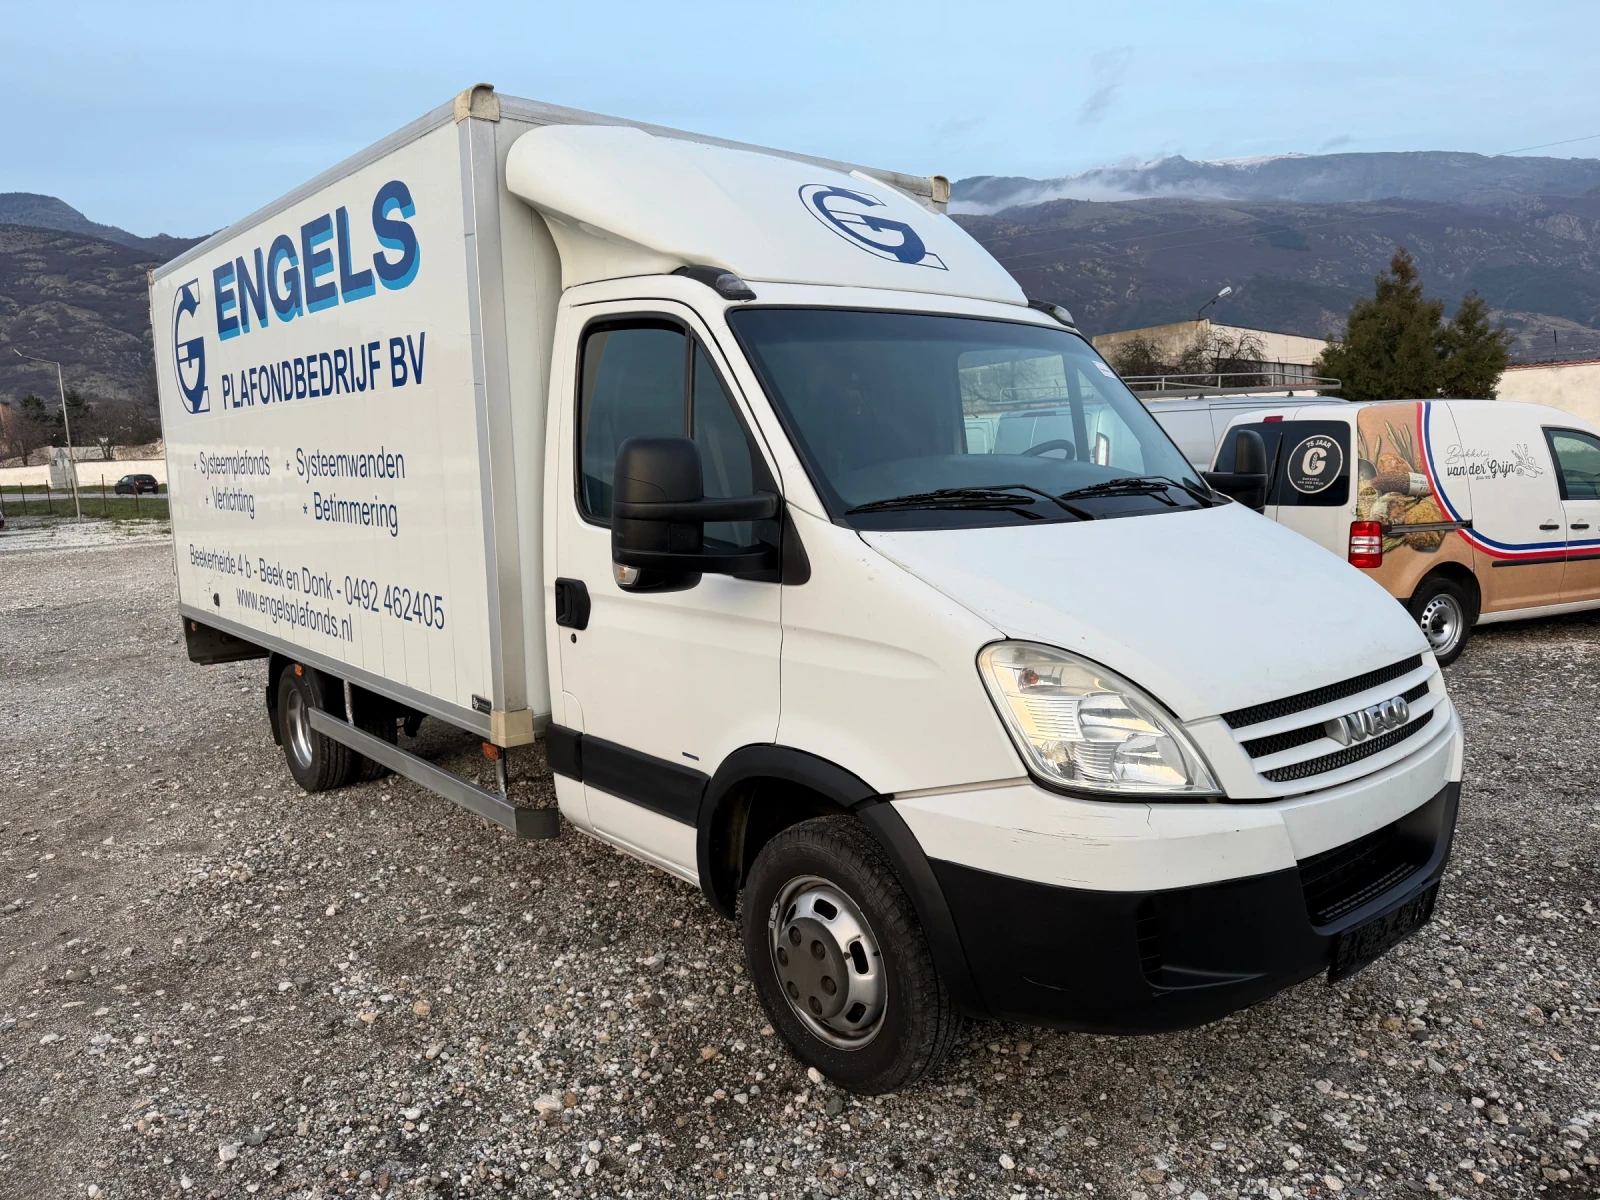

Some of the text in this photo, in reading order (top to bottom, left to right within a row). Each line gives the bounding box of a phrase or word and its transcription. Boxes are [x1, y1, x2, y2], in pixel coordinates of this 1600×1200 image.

[213, 180, 421, 341] ENGELS
[221, 332, 426, 410] PLAFONDBEDRIJF BV
[199, 449, 271, 480] Systeemplafonds
[296, 446, 405, 484] Systeemwanden
[1306, 439, 1332, 449] 75 JAAR
[1447, 460, 1515, 479] van der Grijn
[211, 485, 255, 520] Verlichting
[313, 491, 399, 538] Betimmering
[189, 543, 236, 575] Beekerheide
[237, 553, 244, 577] 4
[244, 554, 252, 579] b
[258, 557, 285, 588] Beek
[286, 569, 300, 592] en
[301, 566, 334, 601] Donk
[344, 575, 380, 613] 0492
[383, 583, 445, 630] 462405
[235, 587, 354, 643] www.engelsplafonds.nl
[1332, 696, 1410, 747] IVECO
